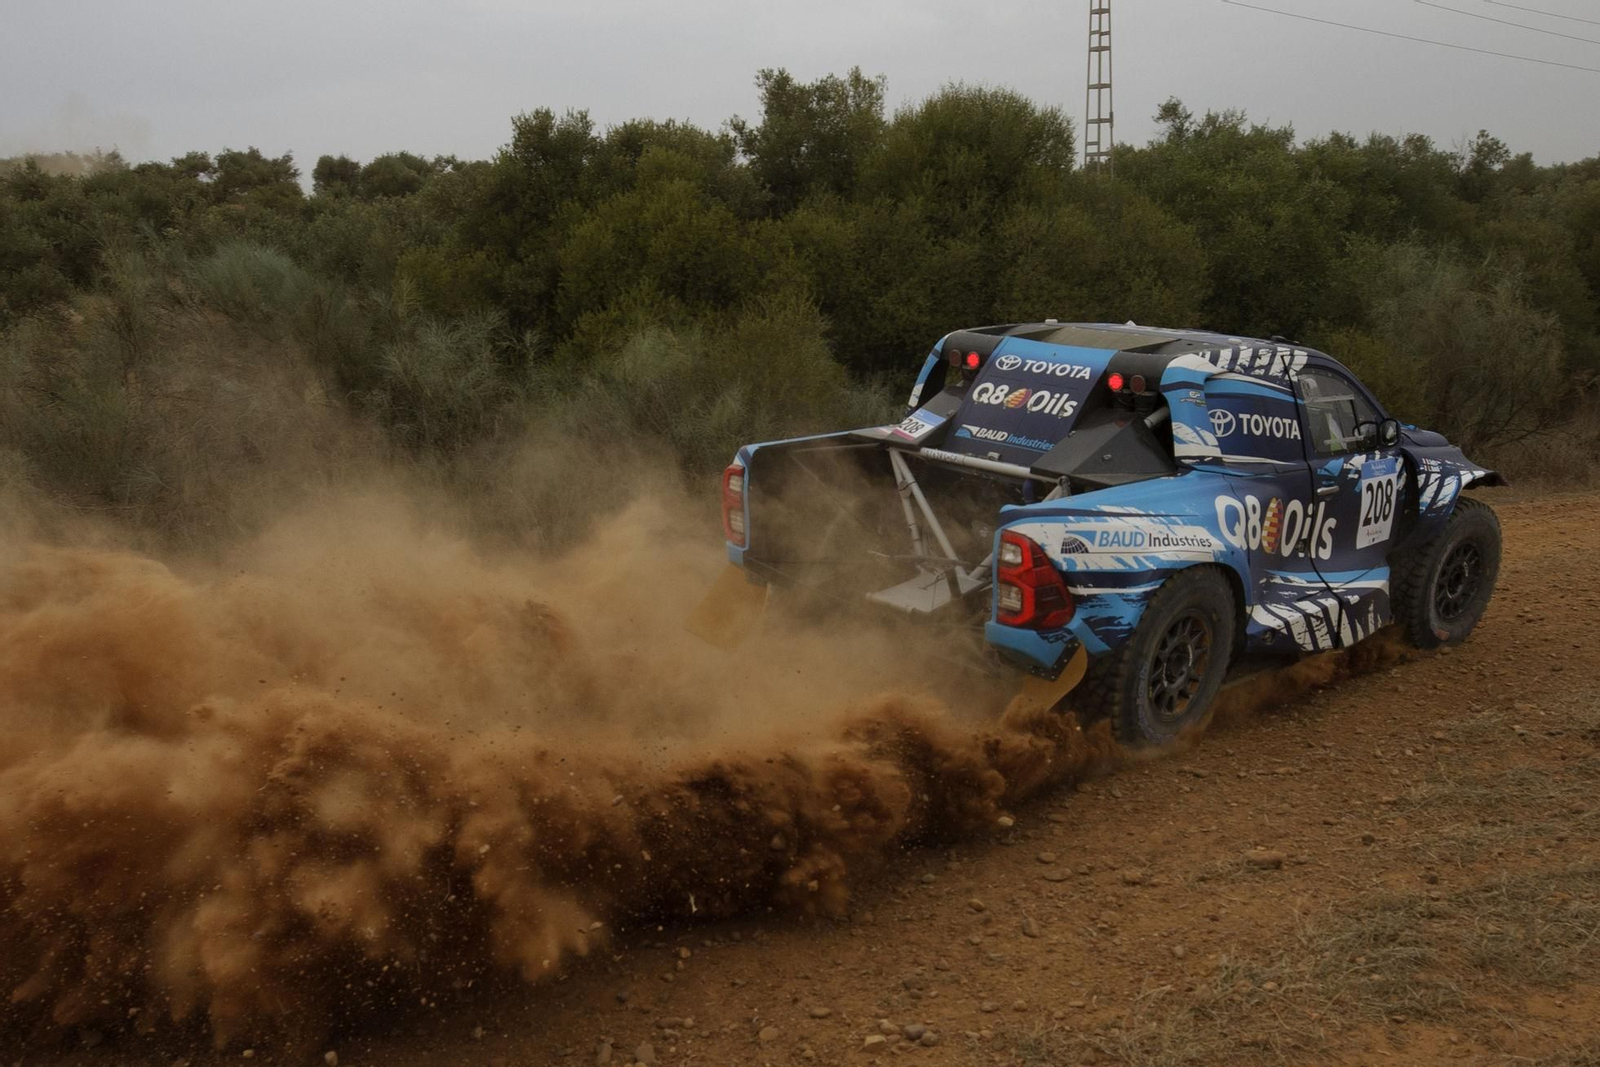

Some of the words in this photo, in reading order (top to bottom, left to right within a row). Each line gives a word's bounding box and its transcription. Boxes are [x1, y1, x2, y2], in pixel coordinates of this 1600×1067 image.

[1023, 359, 1091, 380] TOYOTA
[972, 382, 1010, 403] Q8
[1027, 390, 1078, 417] Oils
[900, 418, 925, 434] 208
[976, 427, 1007, 442] BAUD
[1006, 433, 1055, 450] Industries
[1239, 413, 1301, 440] TOYOTA
[1362, 478, 1394, 527] 208
[1098, 531, 1145, 548] BAUD
[1148, 532, 1212, 548] Industries
[1214, 494, 1261, 551] Q8
[1281, 499, 1337, 560] Oils
